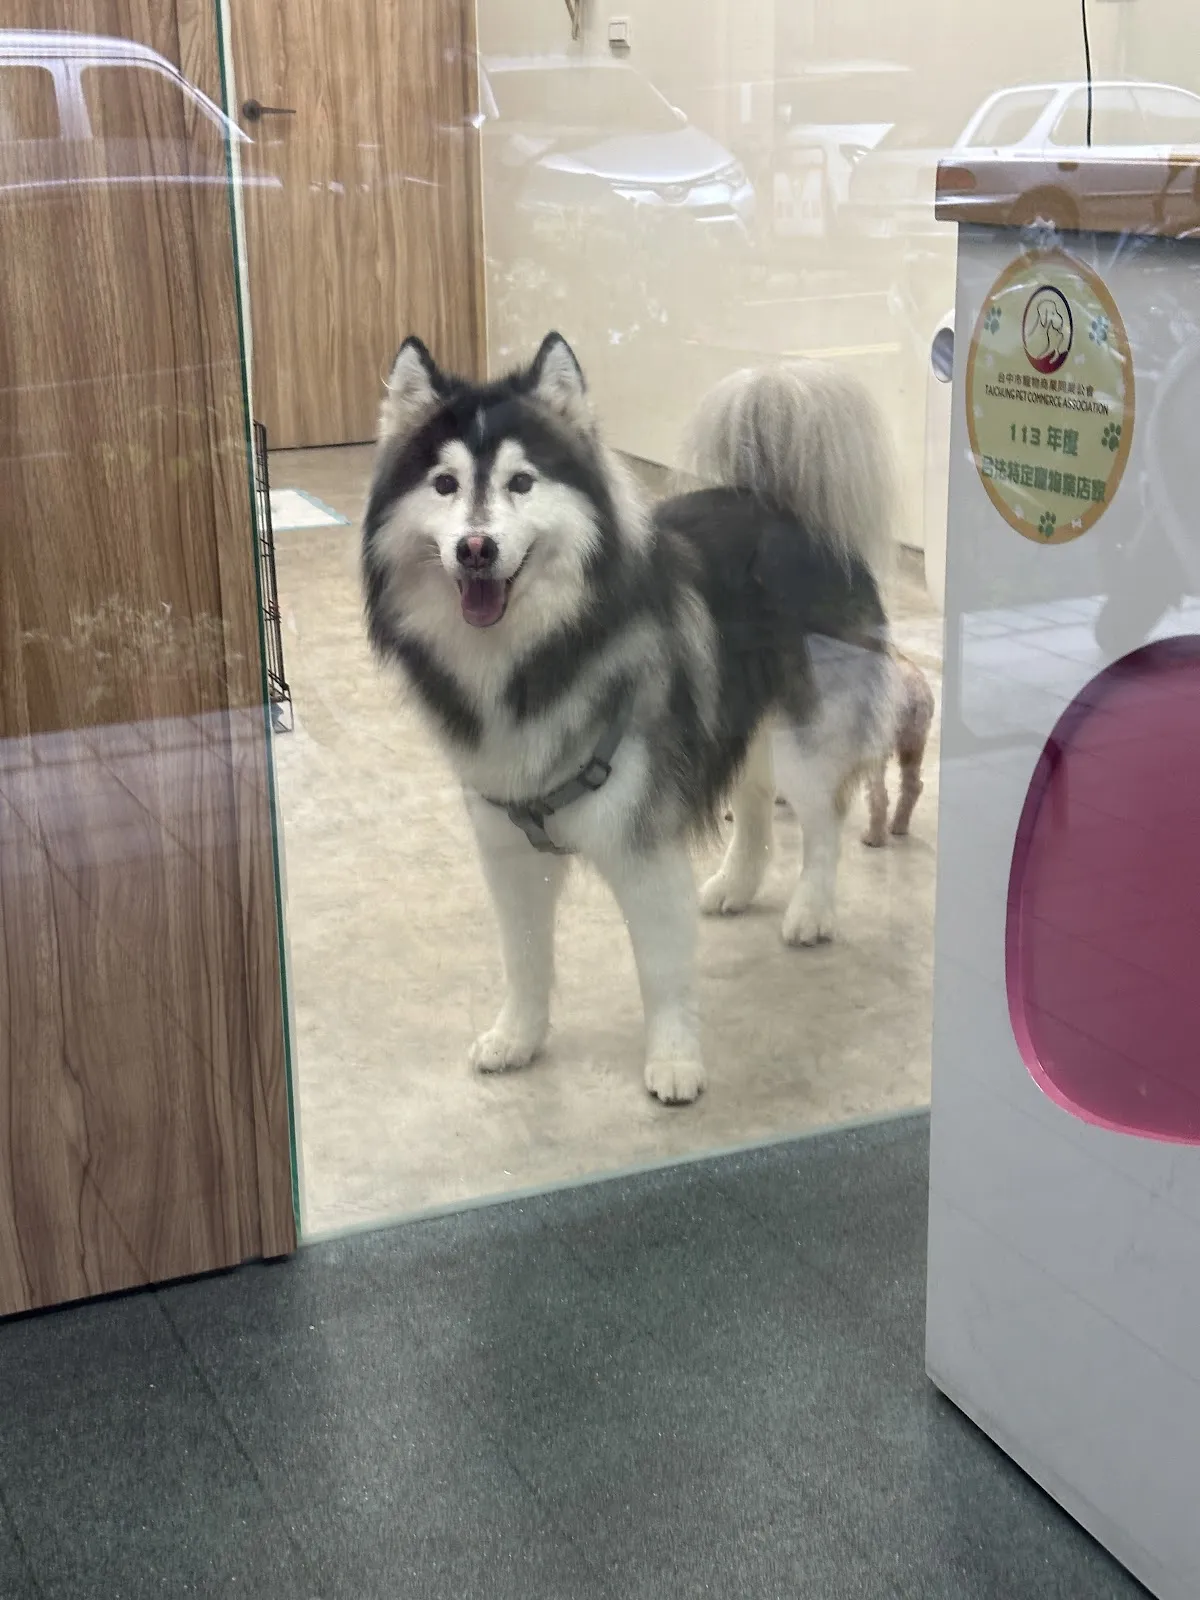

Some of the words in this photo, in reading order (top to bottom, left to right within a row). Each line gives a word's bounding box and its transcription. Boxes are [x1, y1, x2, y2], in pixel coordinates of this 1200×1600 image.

[985, 384, 1015, 400] TAICHUNG
[1015, 390, 1027, 402] PET
[1027, 392, 1062, 408] COMMERCE
[1063, 399, 1108, 416] ASSOCIATION
[1010, 423, 1041, 446] 113
[1046, 425, 1080, 456] 年度
